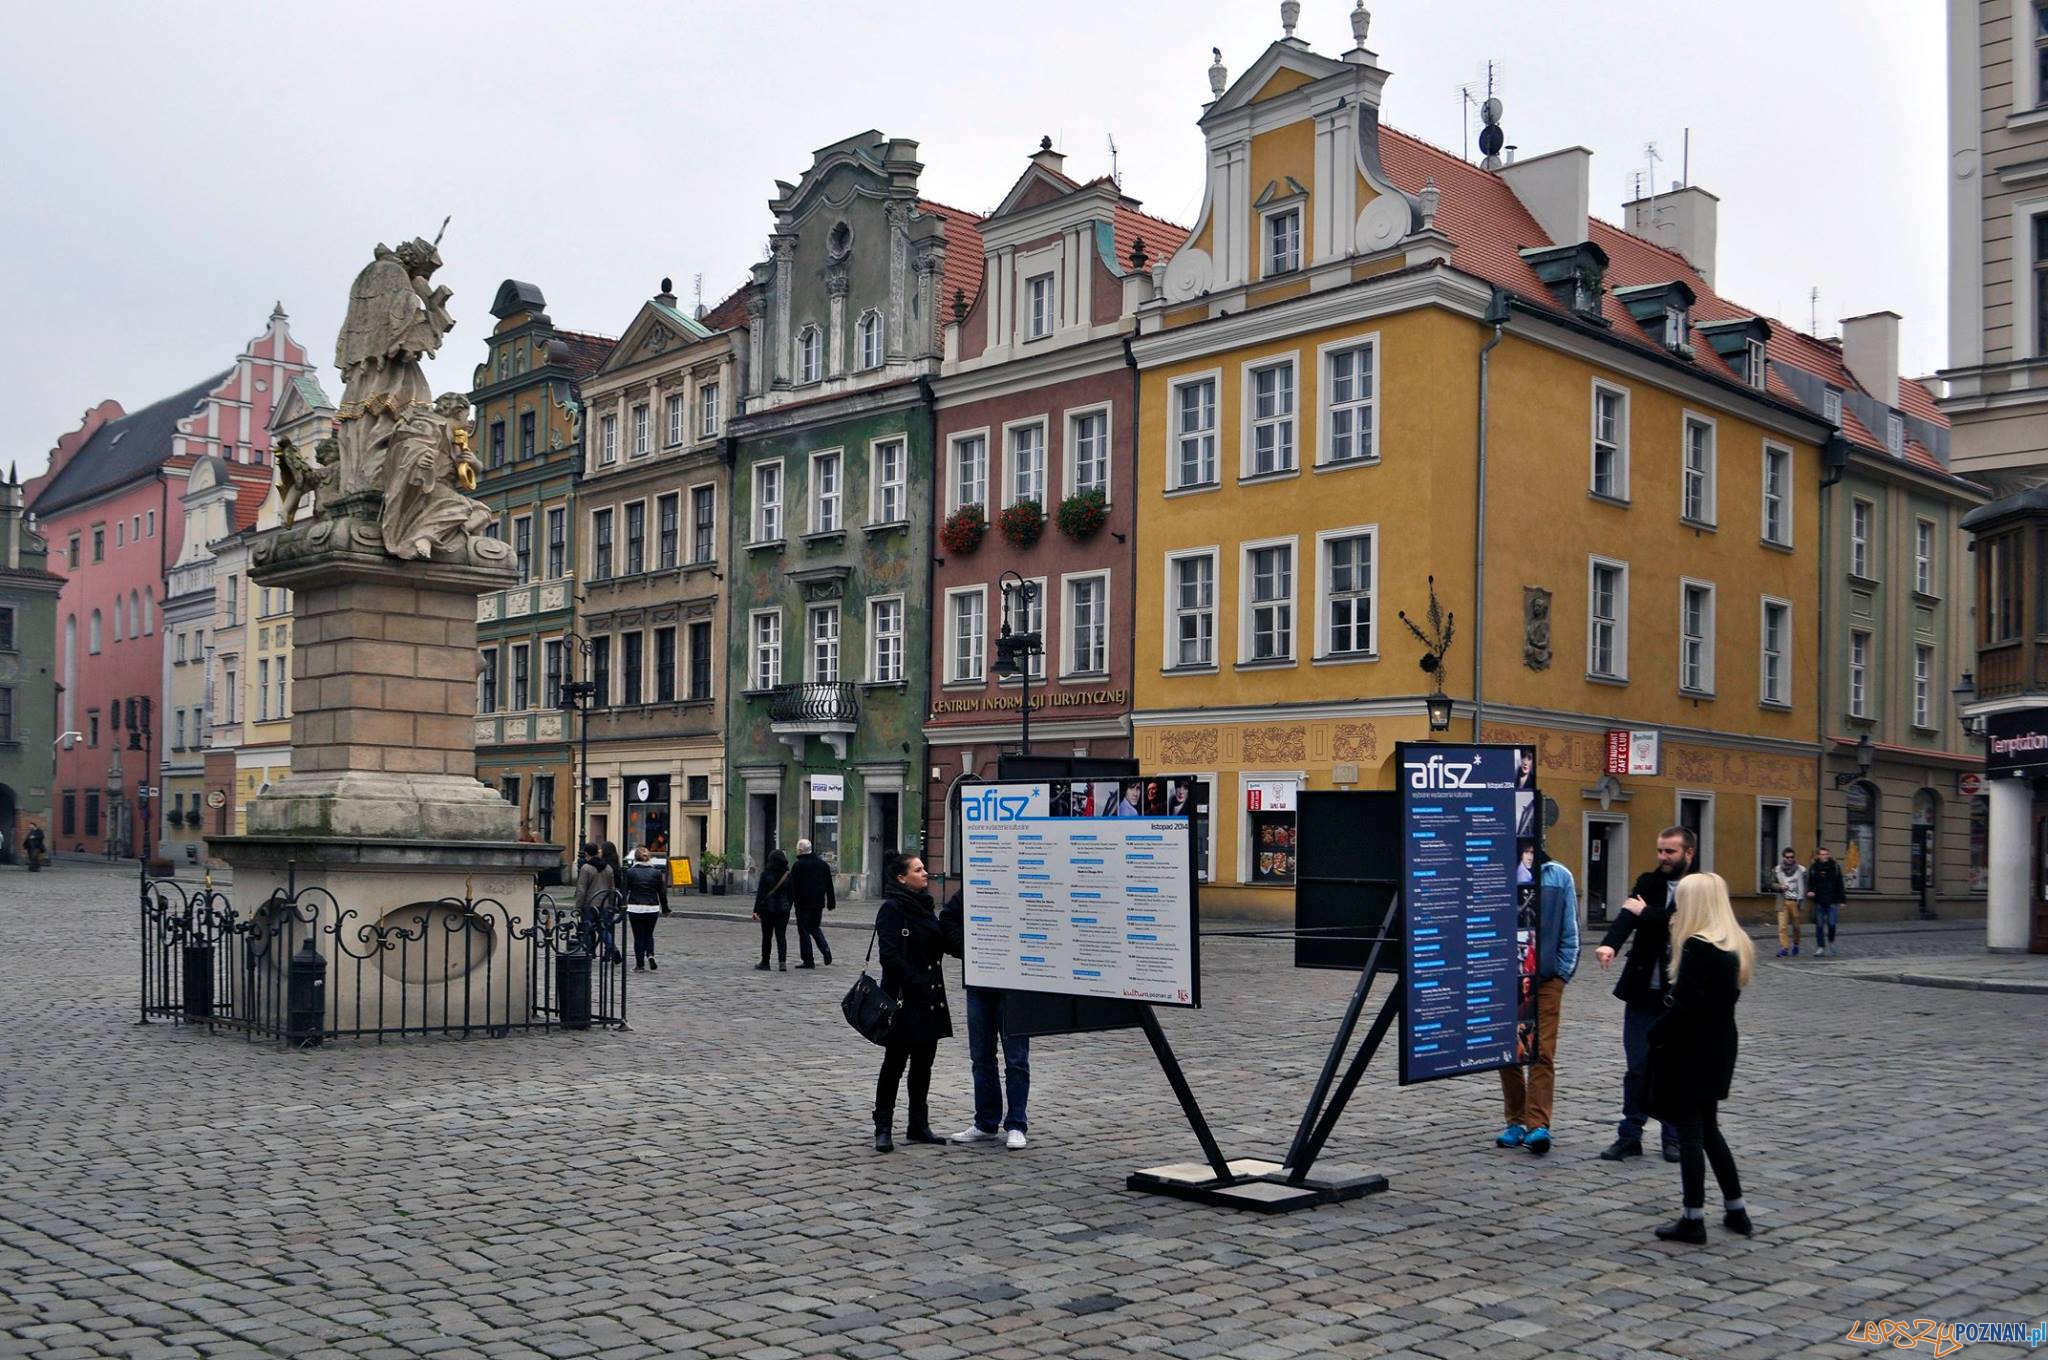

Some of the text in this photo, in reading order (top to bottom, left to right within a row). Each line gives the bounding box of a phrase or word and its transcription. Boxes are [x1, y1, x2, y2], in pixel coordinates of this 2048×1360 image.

[932, 689, 1126, 713] CENTRUM INFORMCJI TURYSTYCZNEJ
[1618, 733, 1627, 773] CAFE CLUB
[1988, 731, 2048, 758] Temptation
[1151, 823, 1173, 831] listopad
